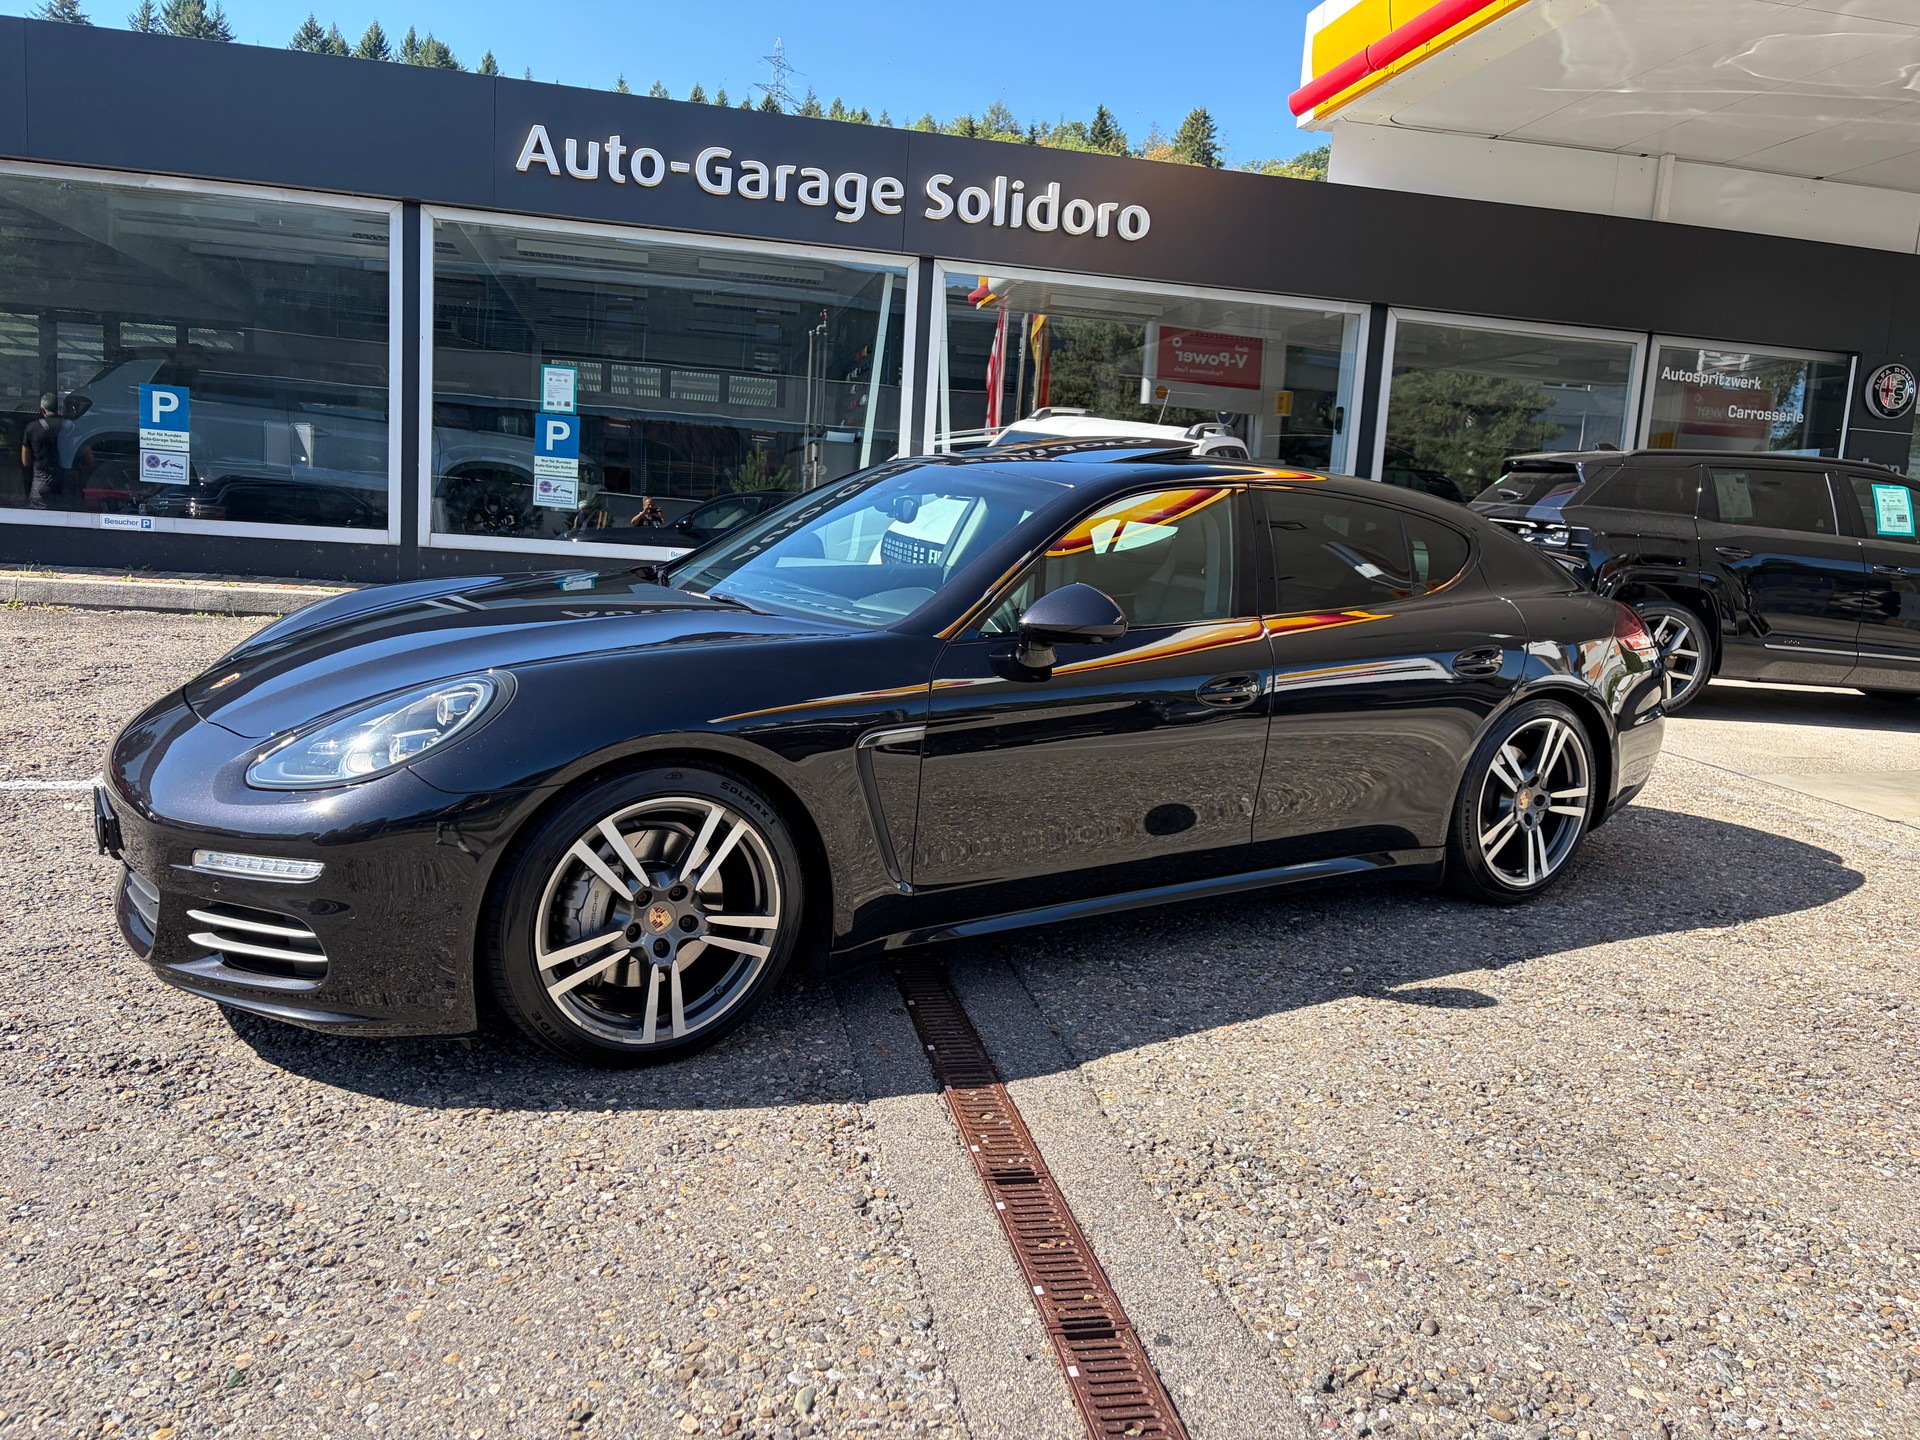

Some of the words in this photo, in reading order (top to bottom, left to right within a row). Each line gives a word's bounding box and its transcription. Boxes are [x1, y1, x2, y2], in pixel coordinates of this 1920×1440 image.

[515, 124, 904, 223] Auto-Garage
[924, 173, 1151, 241] Solidoro
[1661, 366, 1762, 390] Autospritzwerk
[1874, 369, 1892, 391] ALFA
[1894, 367, 1914, 394] ROMEO
[152, 390, 179, 423] P
[1728, 404, 1804, 423] Carrosserie
[546, 420, 571, 451] P
[104, 517, 139, 526] Besucher
[720, 781, 770, 818] SOLMAX
[589, 890, 600, 936] ORSCHE
